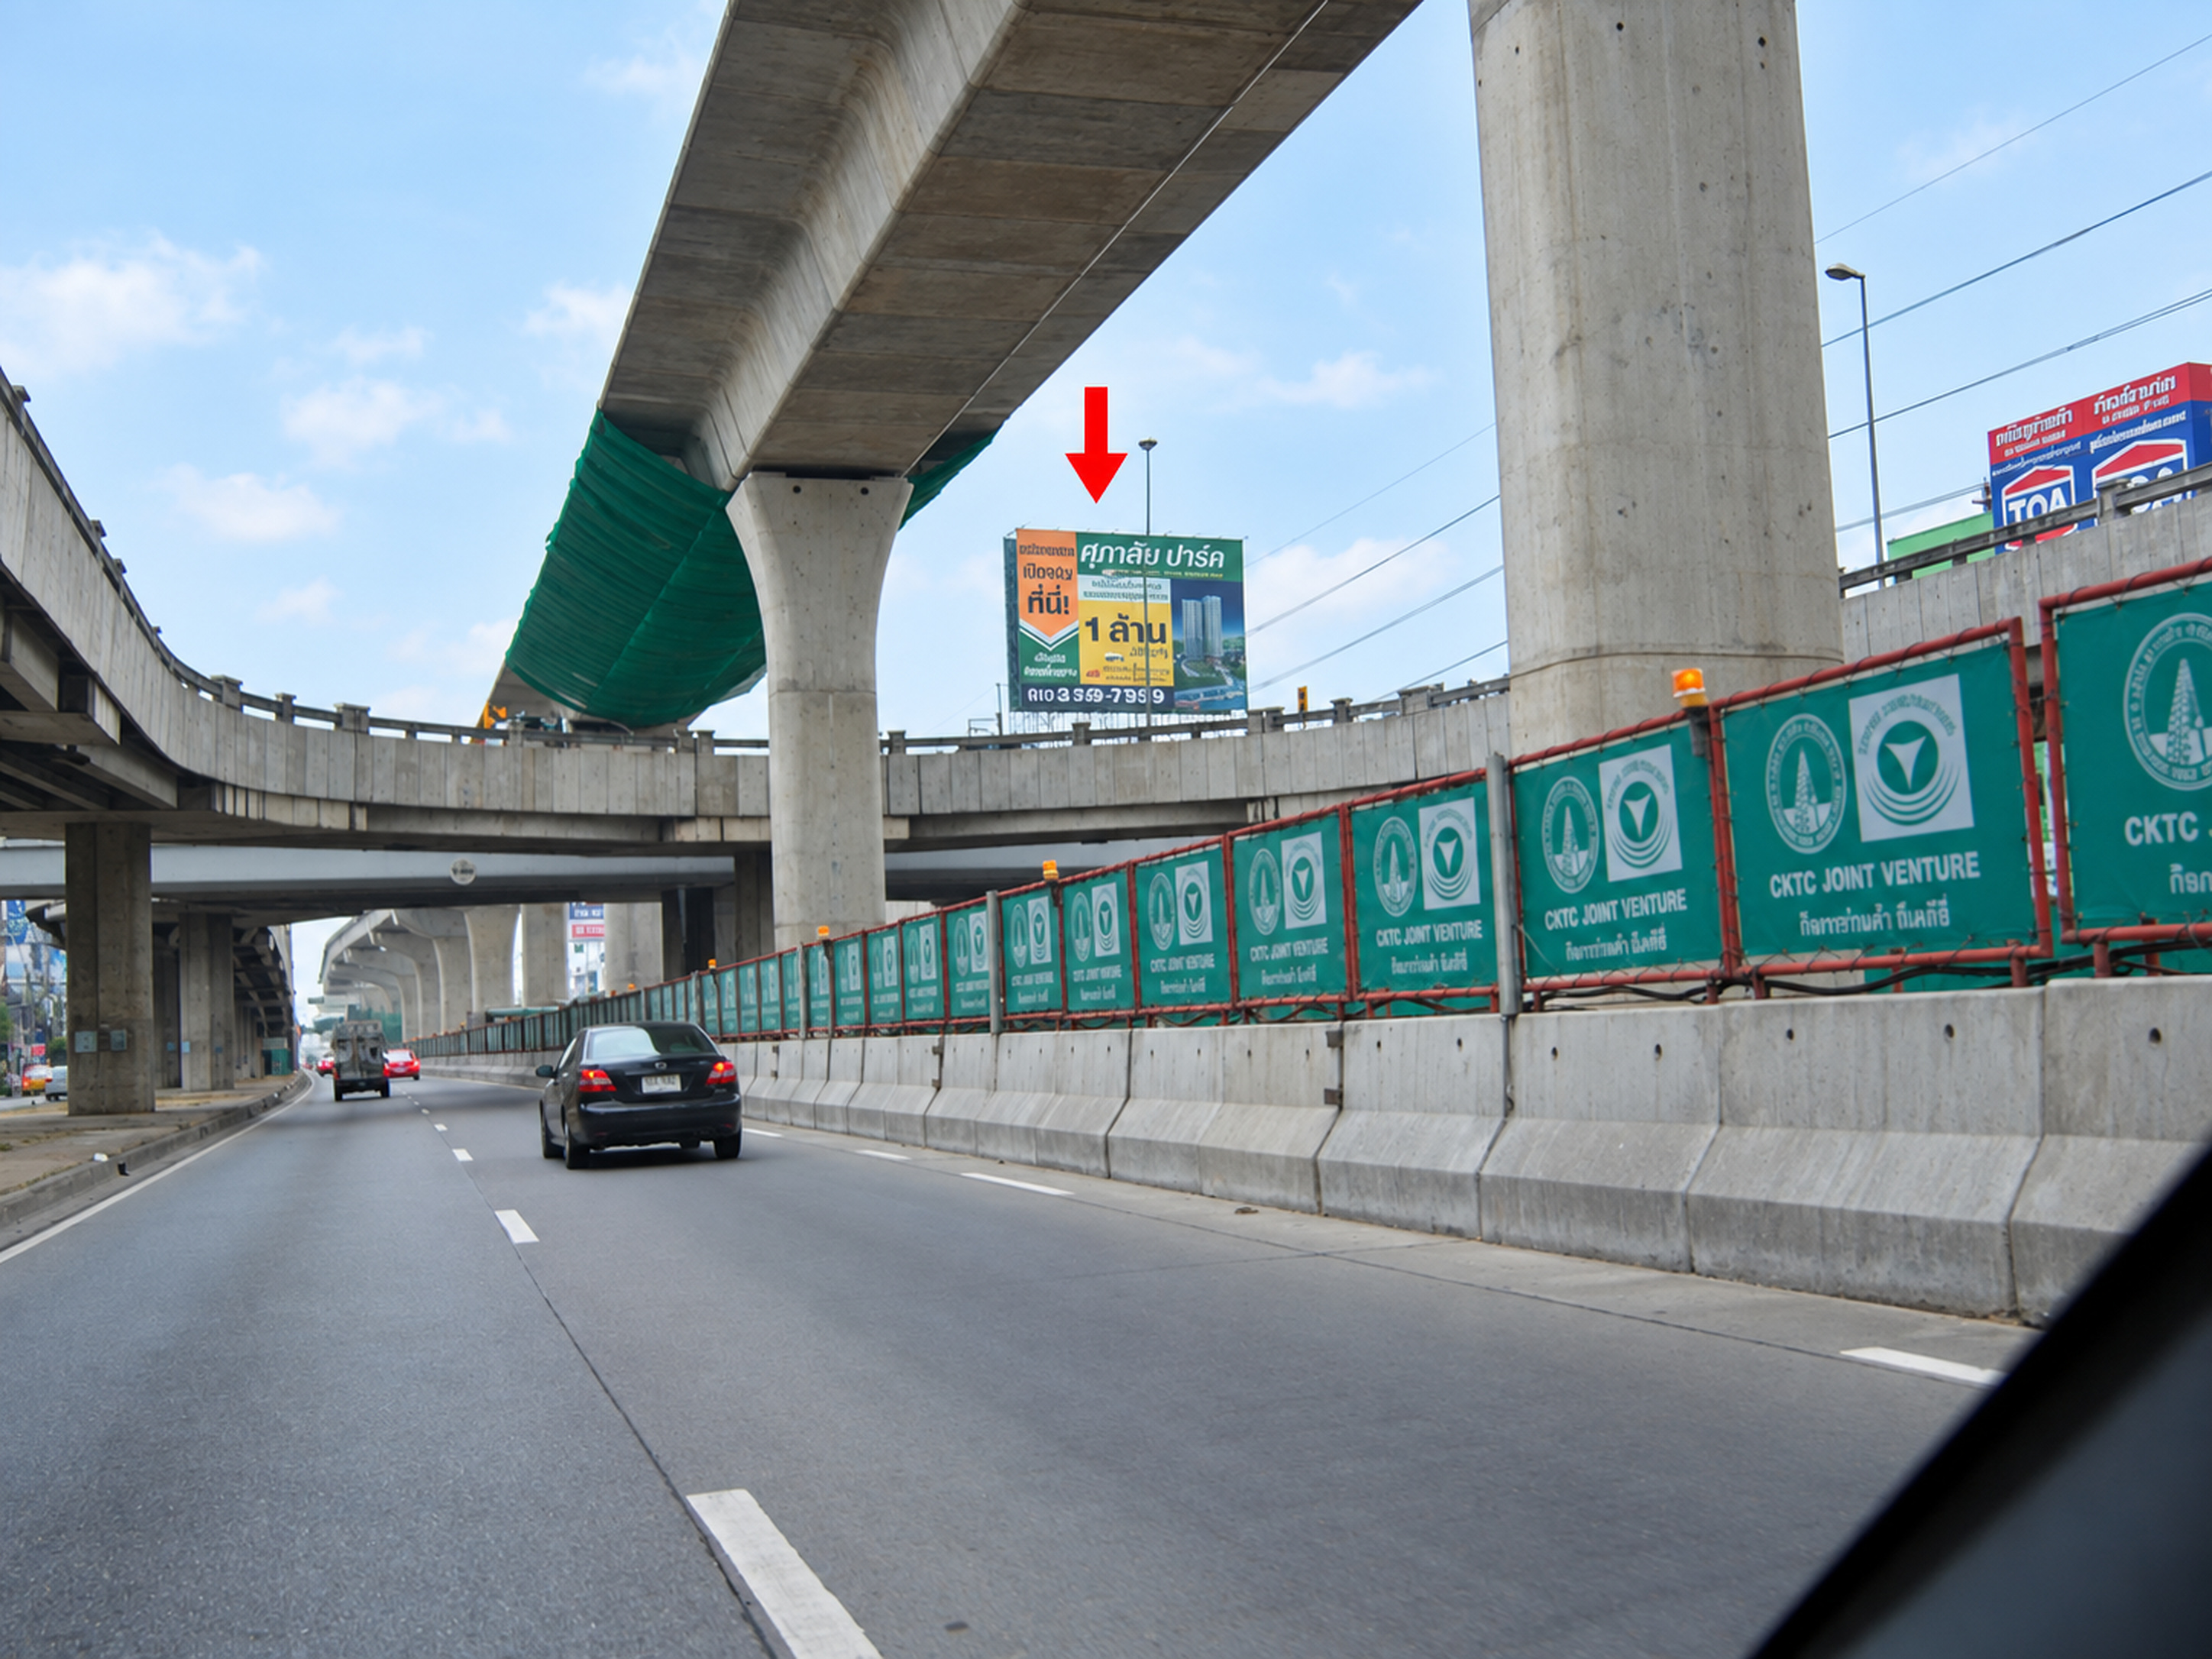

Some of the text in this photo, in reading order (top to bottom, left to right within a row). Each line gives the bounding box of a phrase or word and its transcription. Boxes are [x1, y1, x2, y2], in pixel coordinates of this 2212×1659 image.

[2008, 487, 2068, 522] TOA
[1166, 544, 1224, 568] ปาร์ค
[1085, 613, 1166, 644] 1 ล้าน
[2125, 811, 2198, 846] CKTC
[1770, 851, 1981, 898] CKTC JOINT VENTURE
[1544, 888, 1687, 931] CKTC JOINT VENTURE
